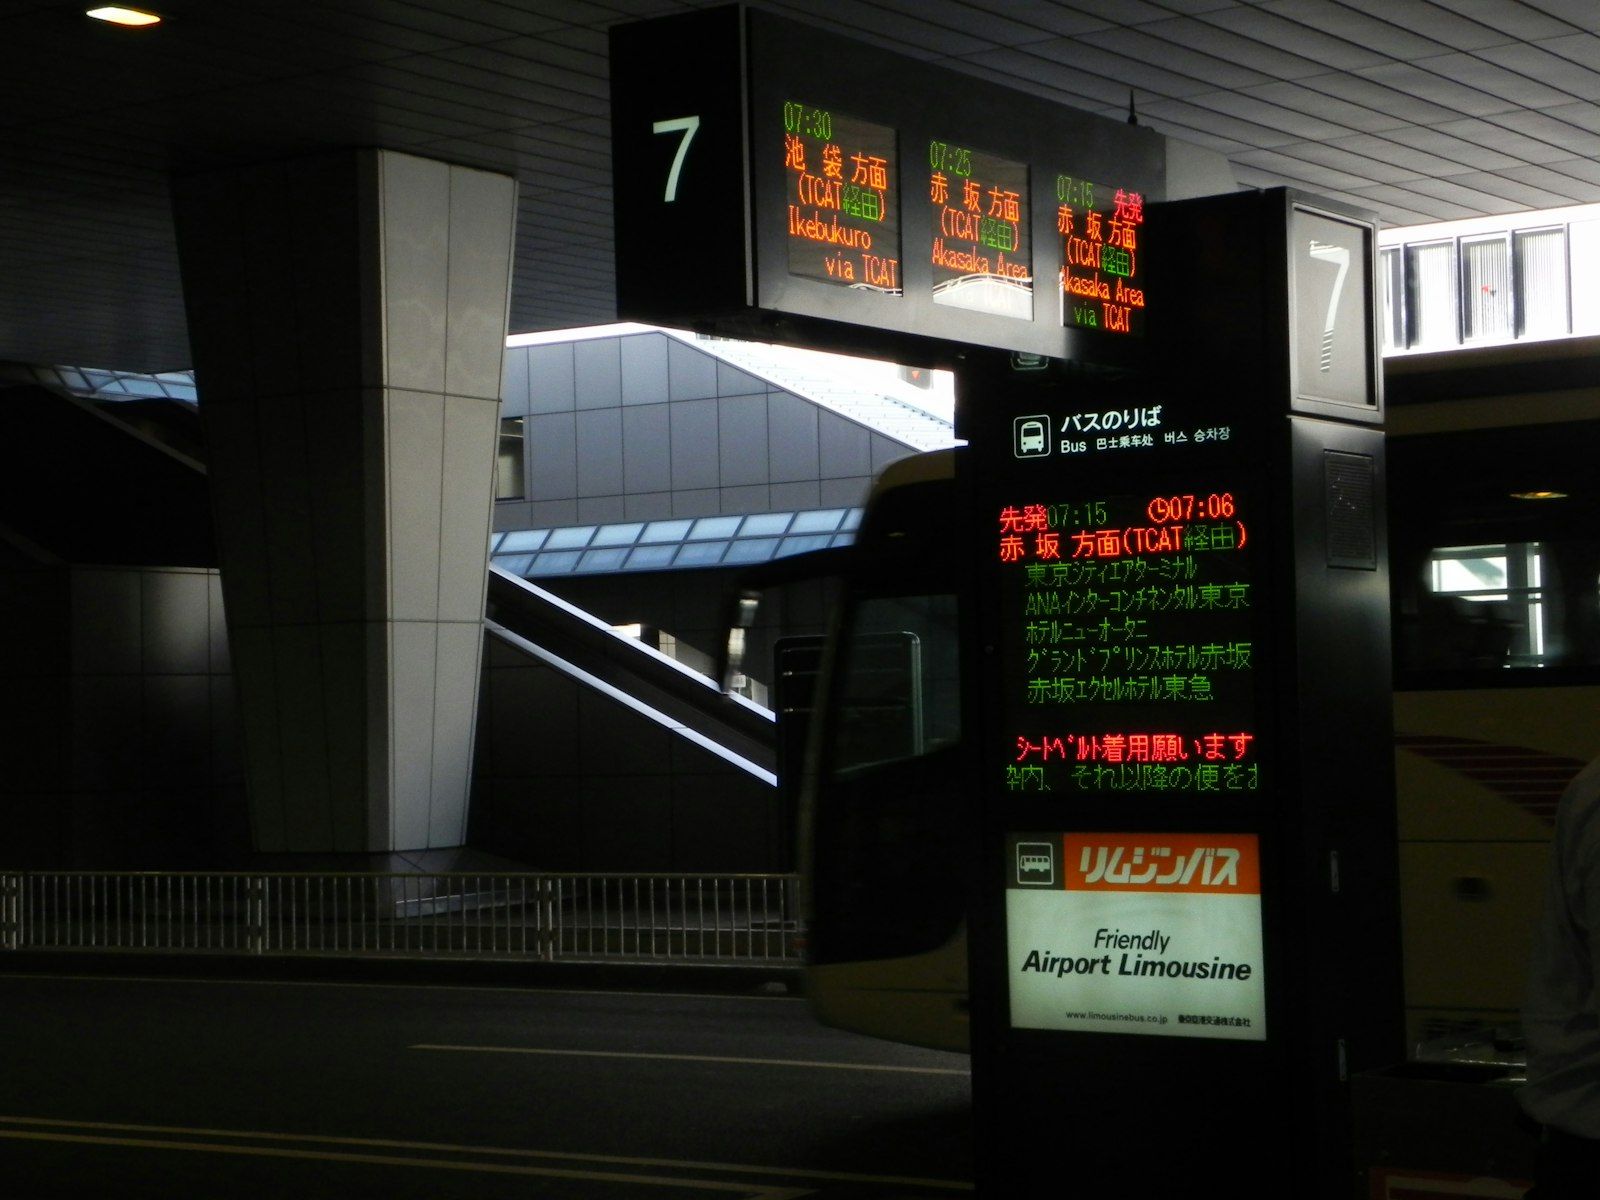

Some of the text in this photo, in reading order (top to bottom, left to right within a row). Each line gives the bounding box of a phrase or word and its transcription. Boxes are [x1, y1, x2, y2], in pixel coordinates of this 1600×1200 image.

[784, 101, 832, 141] 07:30
[653, 115, 700, 203] 7
[930, 140, 972, 176] 07:25
[1056, 175, 1145, 224] 07:15 先発
[788, 205, 871, 249] Ikebukuro
[825, 251, 898, 288] via TCAT
[932, 238, 1029, 279] Akasaka Area
[1063, 266, 1145, 306] Akasaka Area
[1073, 301, 1131, 333] via TCAT
[1309, 240, 1349, 373] 7
[1061, 405, 1162, 433] バスのりば
[1061, 439, 1087, 454] Bus
[1164, 431, 1188, 445] 버스
[1193, 427, 1231, 443] 승차장
[1000, 493, 1235, 534] 先発 07:15 07:06
[1079, 846, 1241, 886] リムジンバス
[1094, 929, 1170, 955] Friendly
[1021, 950, 1252, 981] Airport Limousine
[1066, 1010, 1168, 1024] www.limousinebus.co.jp
